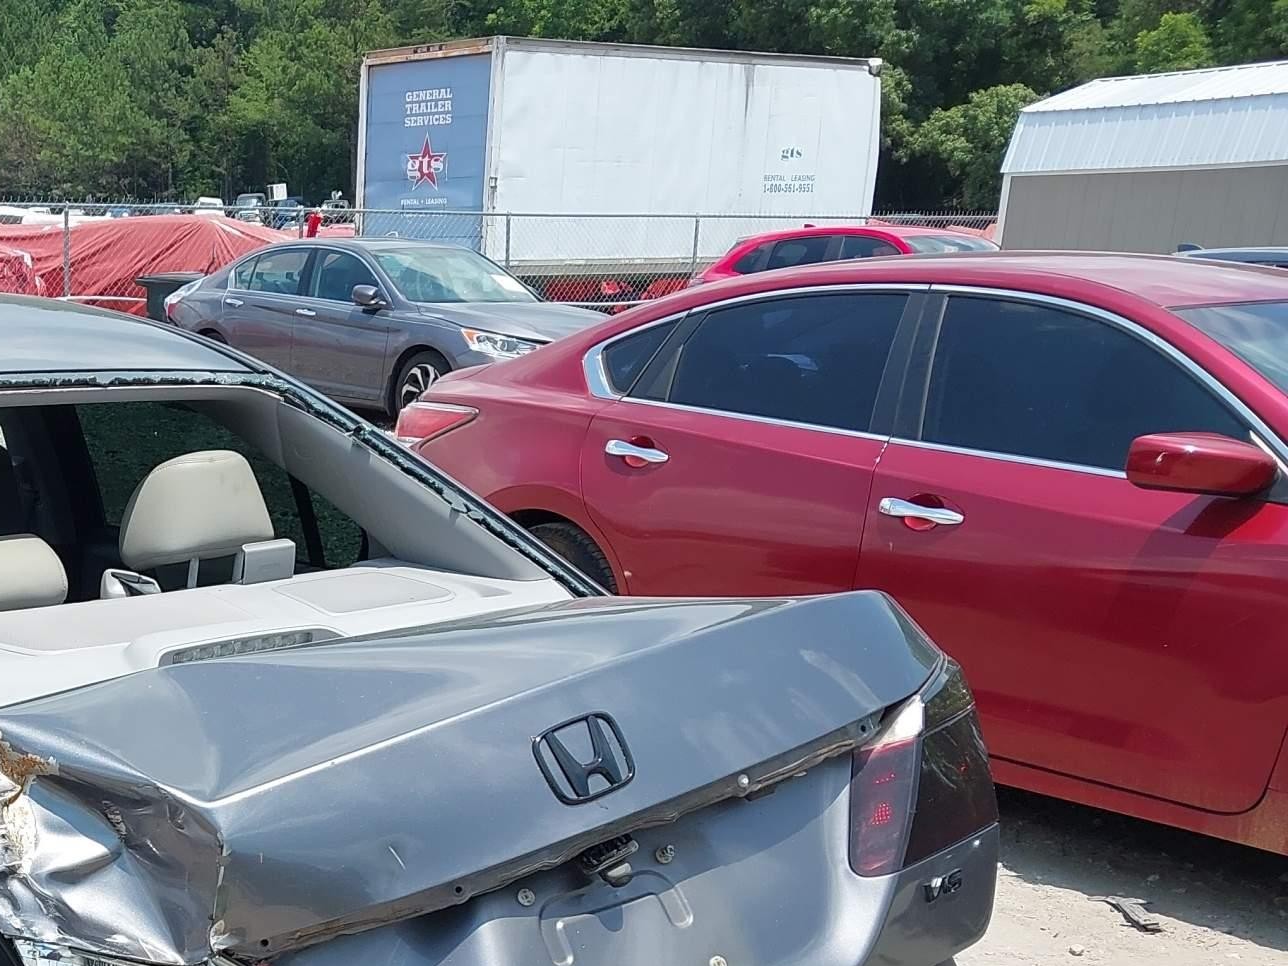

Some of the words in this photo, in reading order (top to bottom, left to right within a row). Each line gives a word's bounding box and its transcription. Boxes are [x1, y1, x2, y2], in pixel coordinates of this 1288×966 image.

[405, 88, 453, 101] GENERAL
[405, 100, 452, 114] TRAILER
[404, 114, 452, 127] SERVICES
[781, 148, 803, 161] gts
[407, 153, 444, 181] gts
